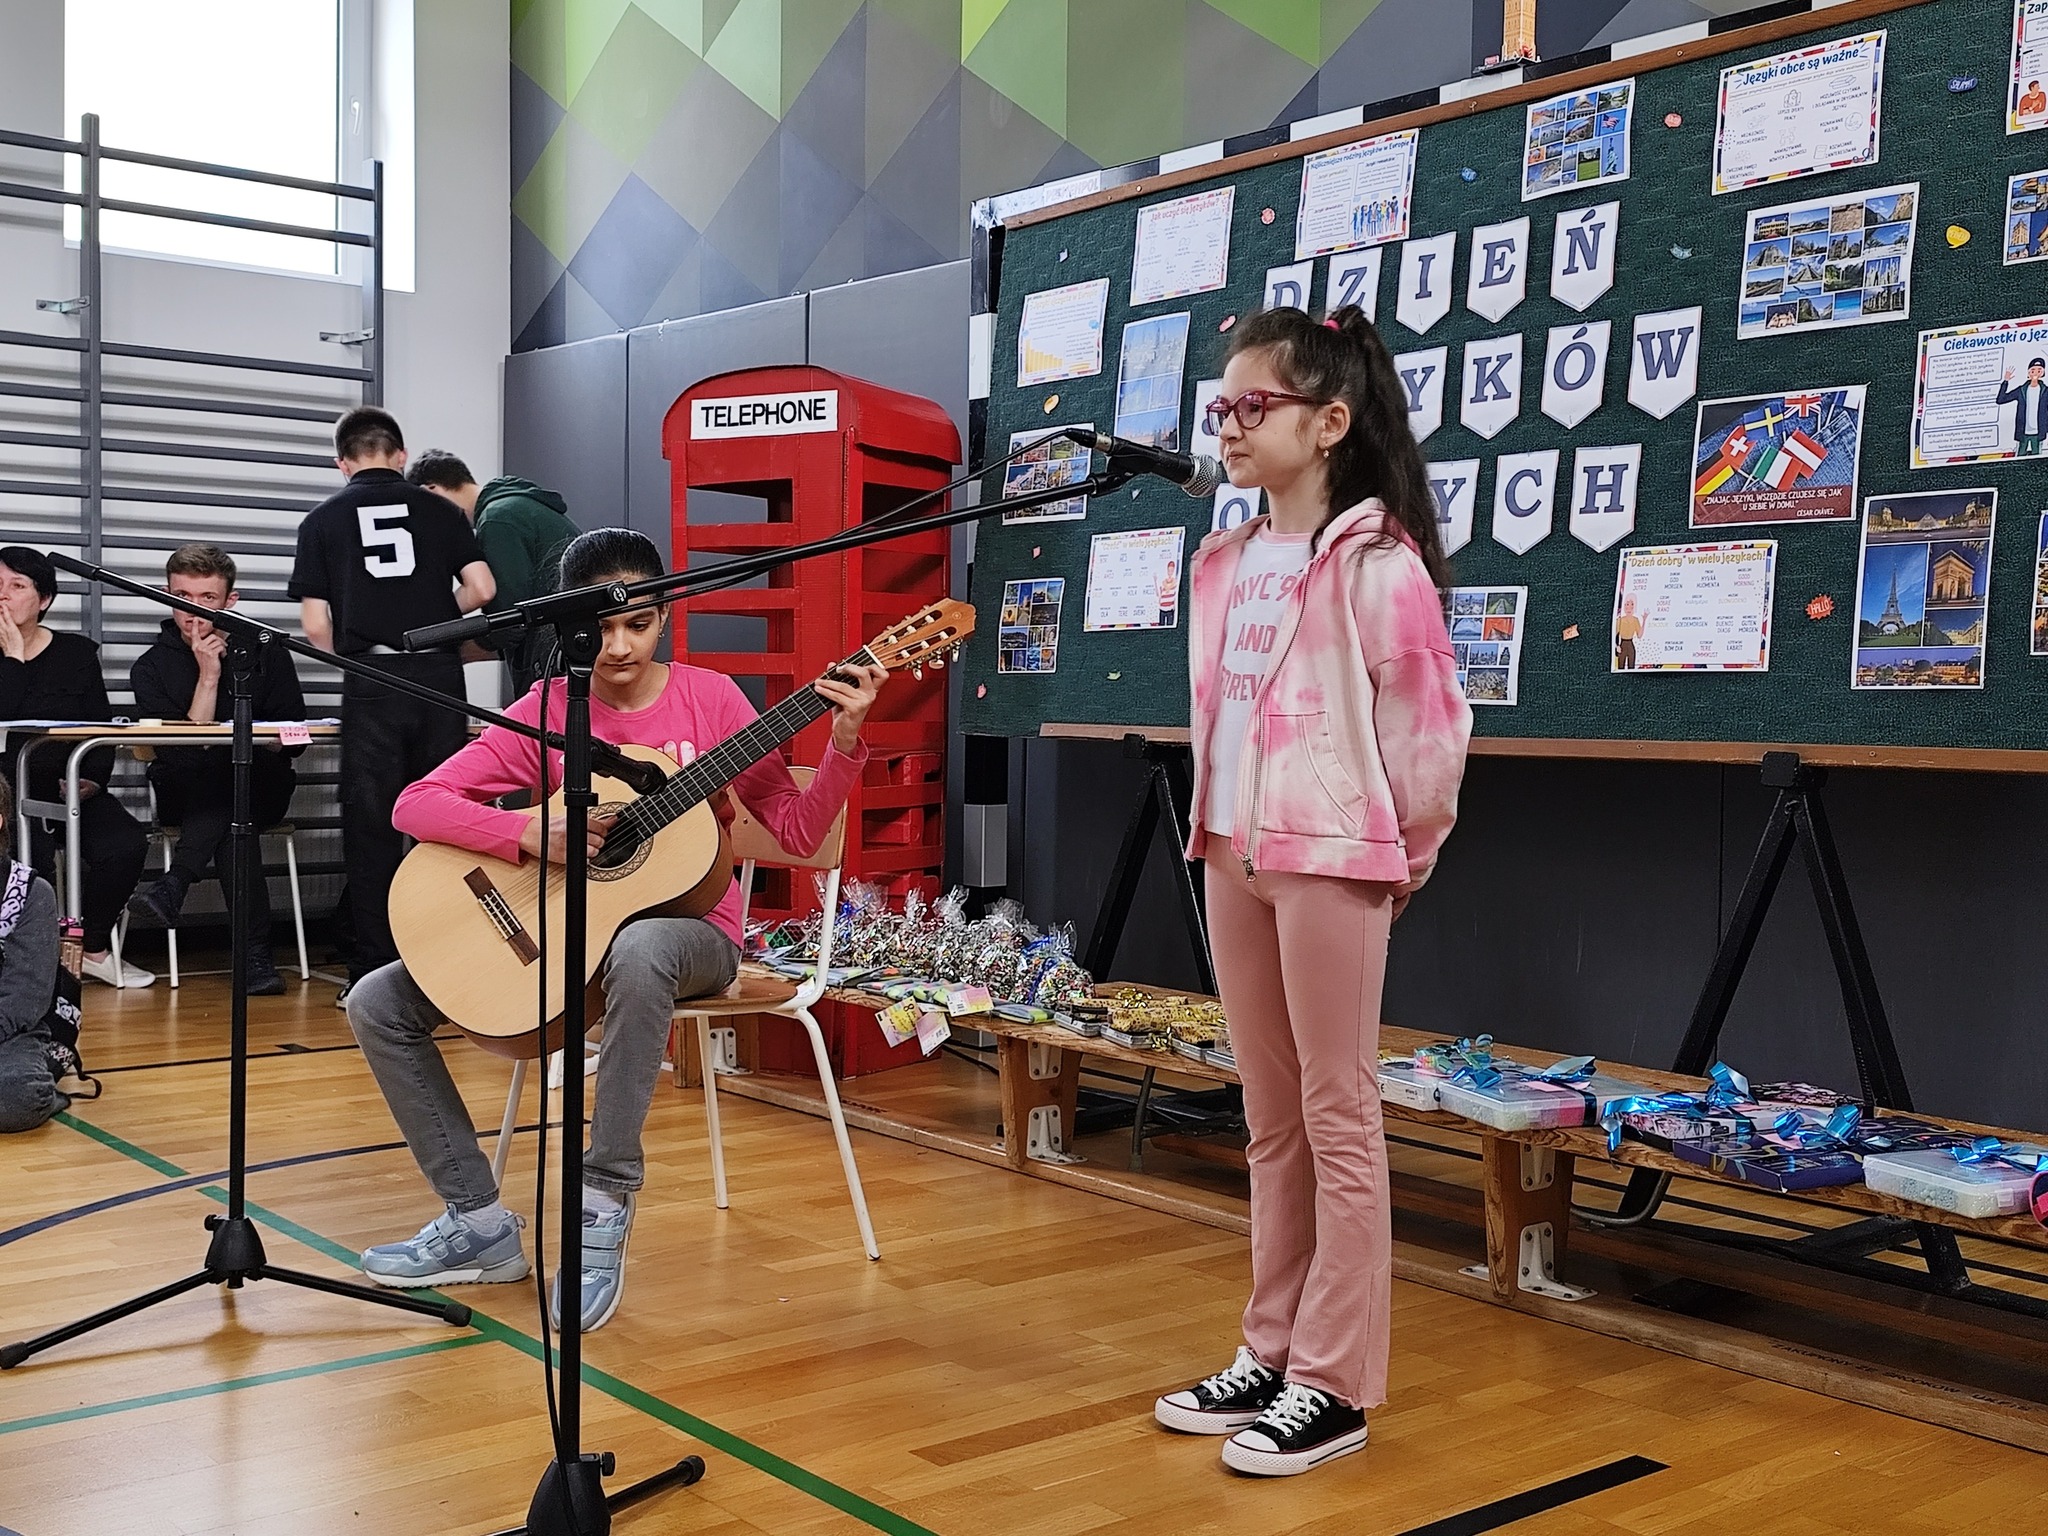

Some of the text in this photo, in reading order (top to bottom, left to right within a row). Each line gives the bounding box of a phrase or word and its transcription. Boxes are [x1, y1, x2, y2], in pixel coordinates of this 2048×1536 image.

[1743, 48, 1859, 85] Języki obce są ważne
[1944, 330, 2017, 351] Ciekawostki
[2020, 332, 2027, 341] o
[701, 398, 826, 428] TELEPHONE
[1756, 492, 1787, 502] WSZĘDZIE
[1787, 490, 1816, 499] CZUJESZ
[1817, 489, 1828, 498] SIĘ
[1828, 488, 1843, 497] JAK
[1742, 503, 1748, 511] U
[1748, 502, 1768, 511] SIEBIE
[1768, 501, 1776, 510] W
[1797, 508, 1814, 517] CÉSAR
[357, 504, 416, 578] 5
[1688, 556, 1696, 564] w
[1698, 553, 1720, 564] wielu
[1721, 550, 1766, 564] językach!
[1233, 568, 1304, 609] NYC '9
[1810, 600, 1830, 615] HALLO
[1234, 623, 1277, 654] AND
